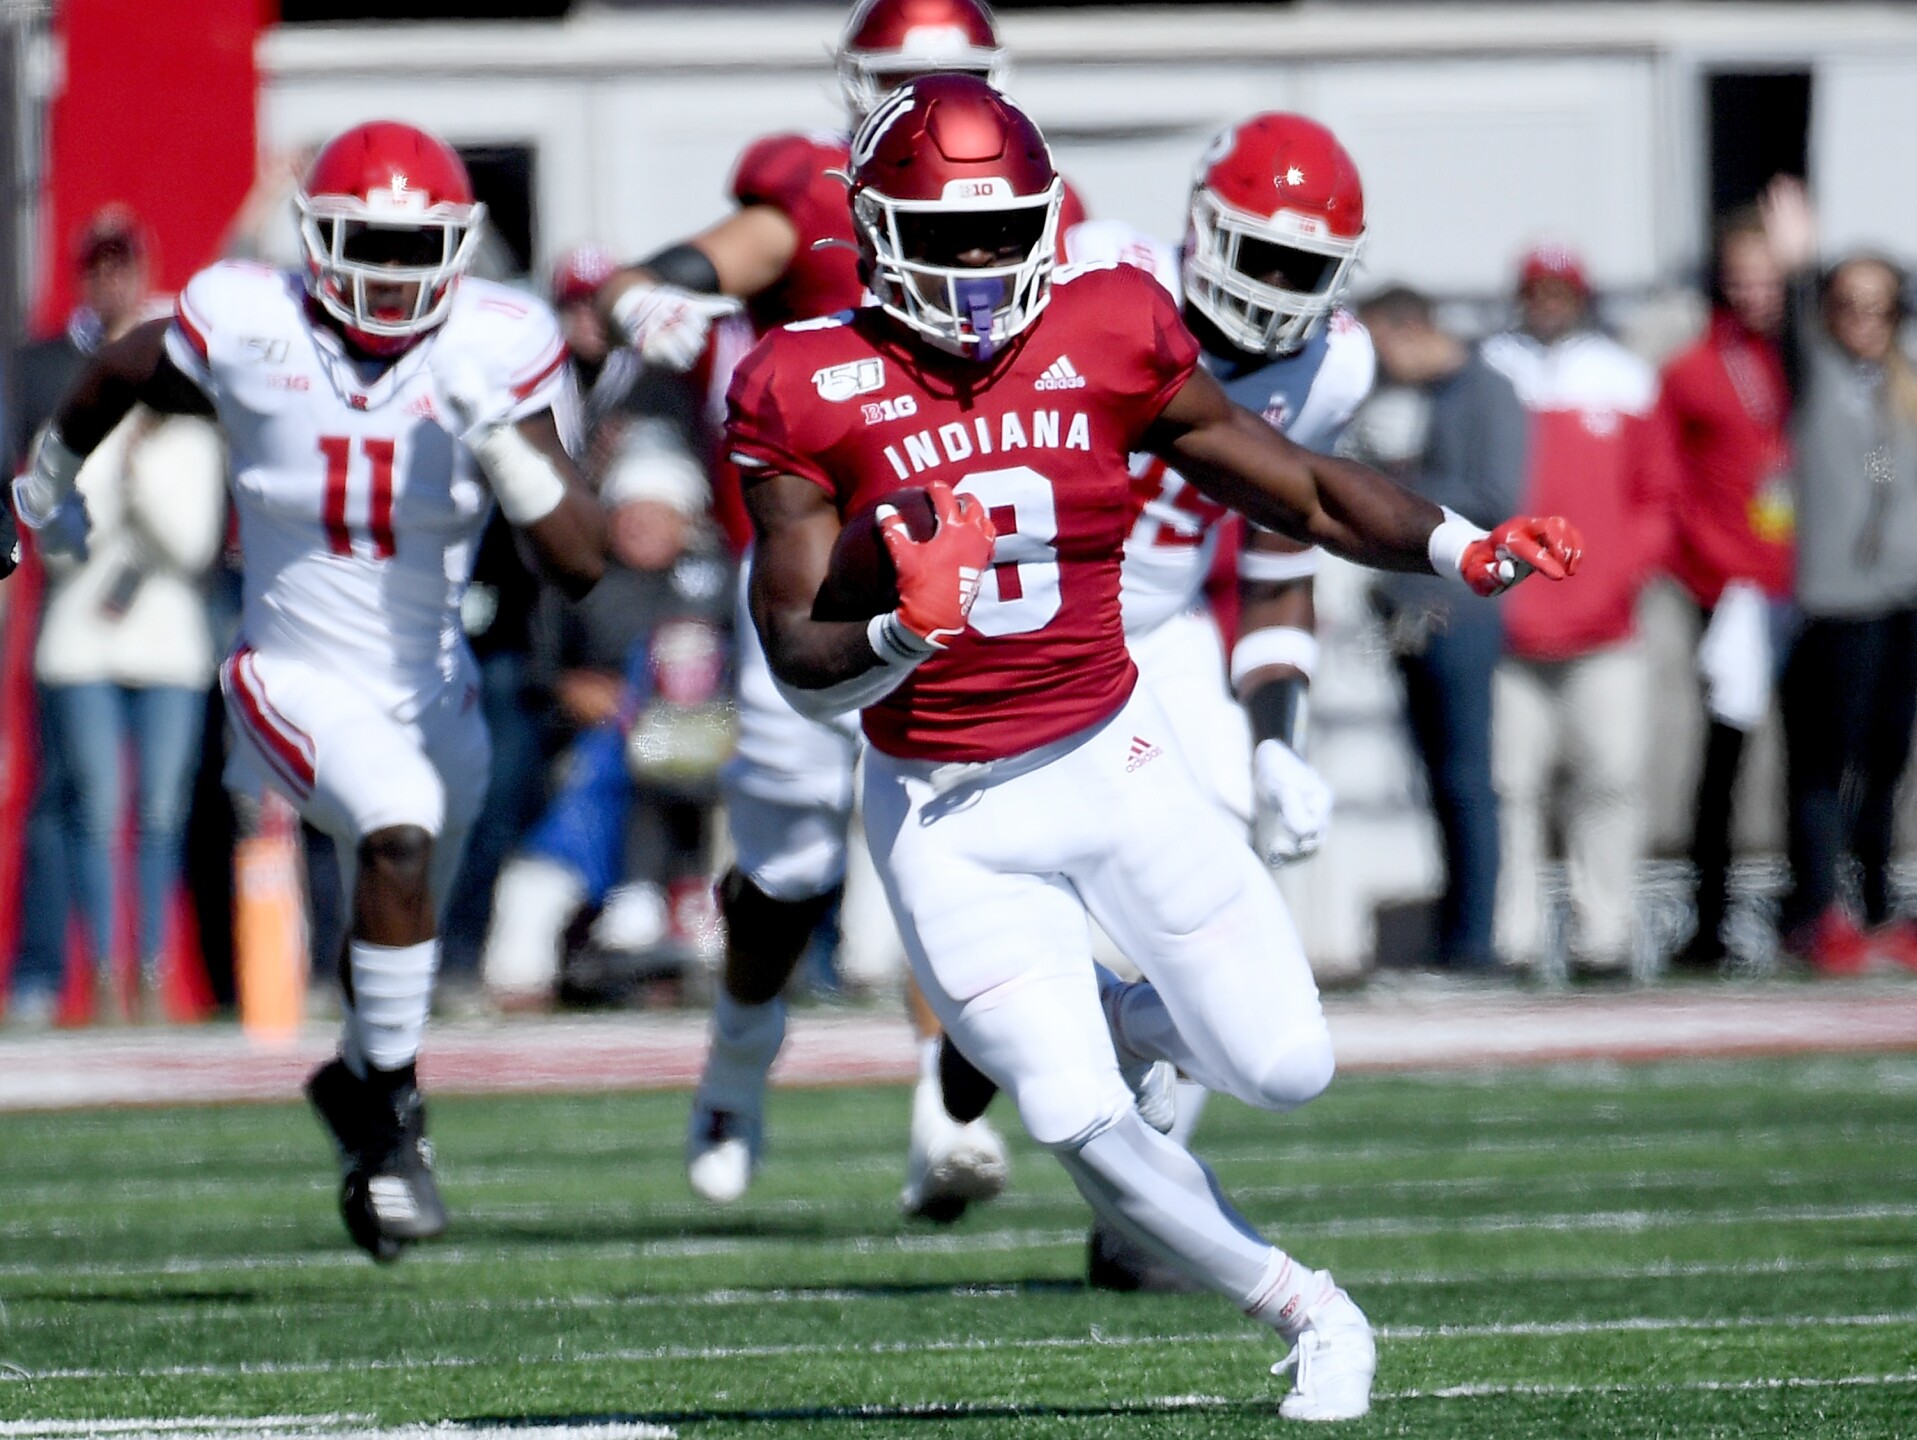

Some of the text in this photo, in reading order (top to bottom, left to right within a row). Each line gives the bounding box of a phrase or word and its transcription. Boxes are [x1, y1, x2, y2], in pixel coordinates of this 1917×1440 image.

[811, 357, 885, 403] 150
[1034, 375, 1086, 391] adidas
[861, 395, 917, 425] B1G
[884, 410, 1090, 480] INDIANA
[317, 435, 397, 560] 11
[952, 466, 1062, 637] 8
